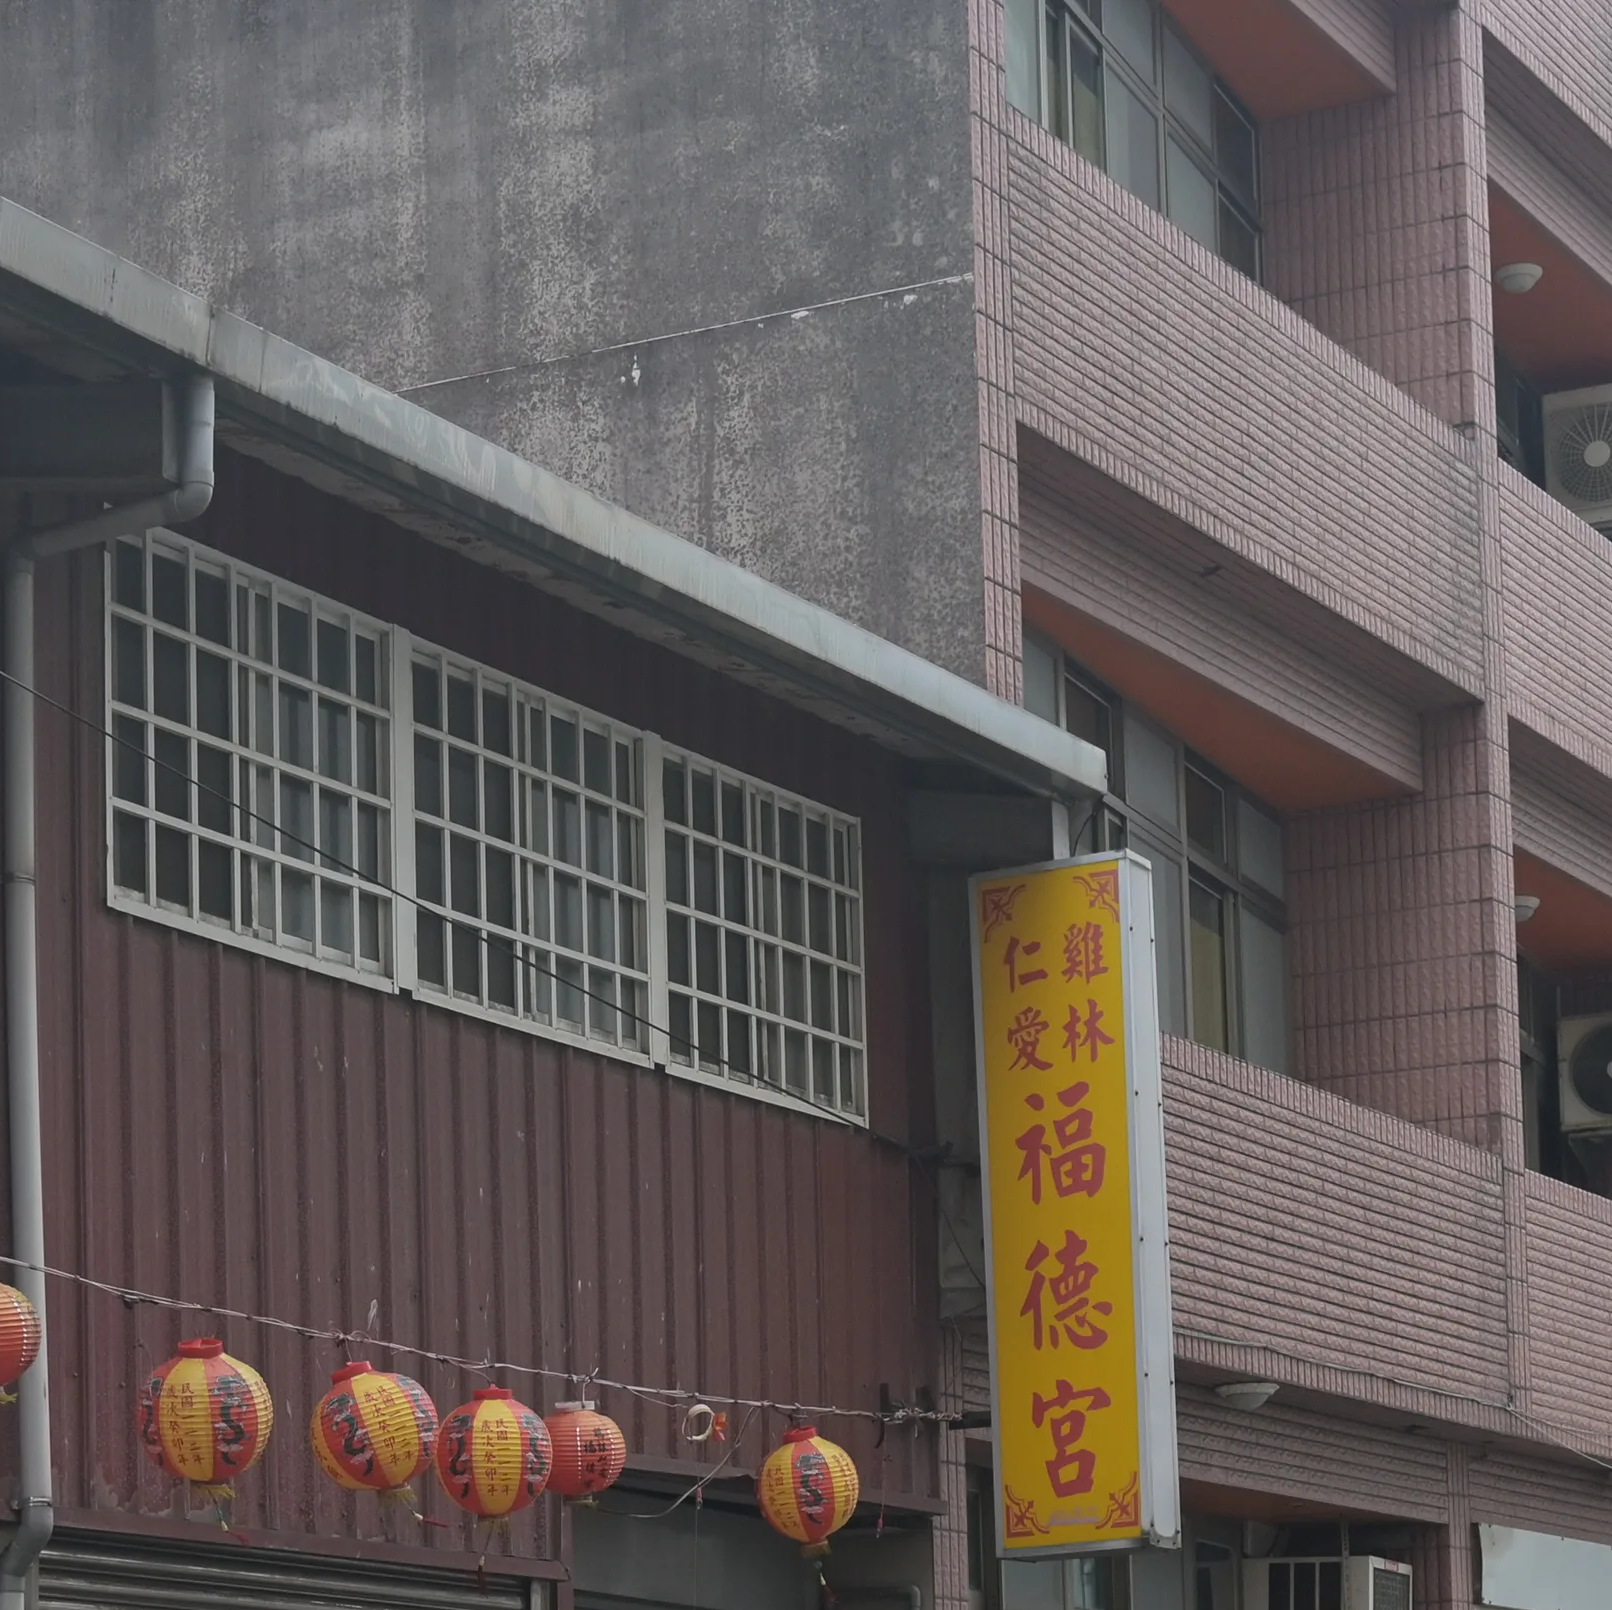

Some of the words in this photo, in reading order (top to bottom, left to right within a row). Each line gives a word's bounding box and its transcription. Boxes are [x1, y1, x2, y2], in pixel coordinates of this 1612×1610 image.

[1003, 936, 1053, 1071] 仁愛
[1062, 922, 1114, 1062] 雞林
[1015, 1081, 1113, 1498] 福德宮
